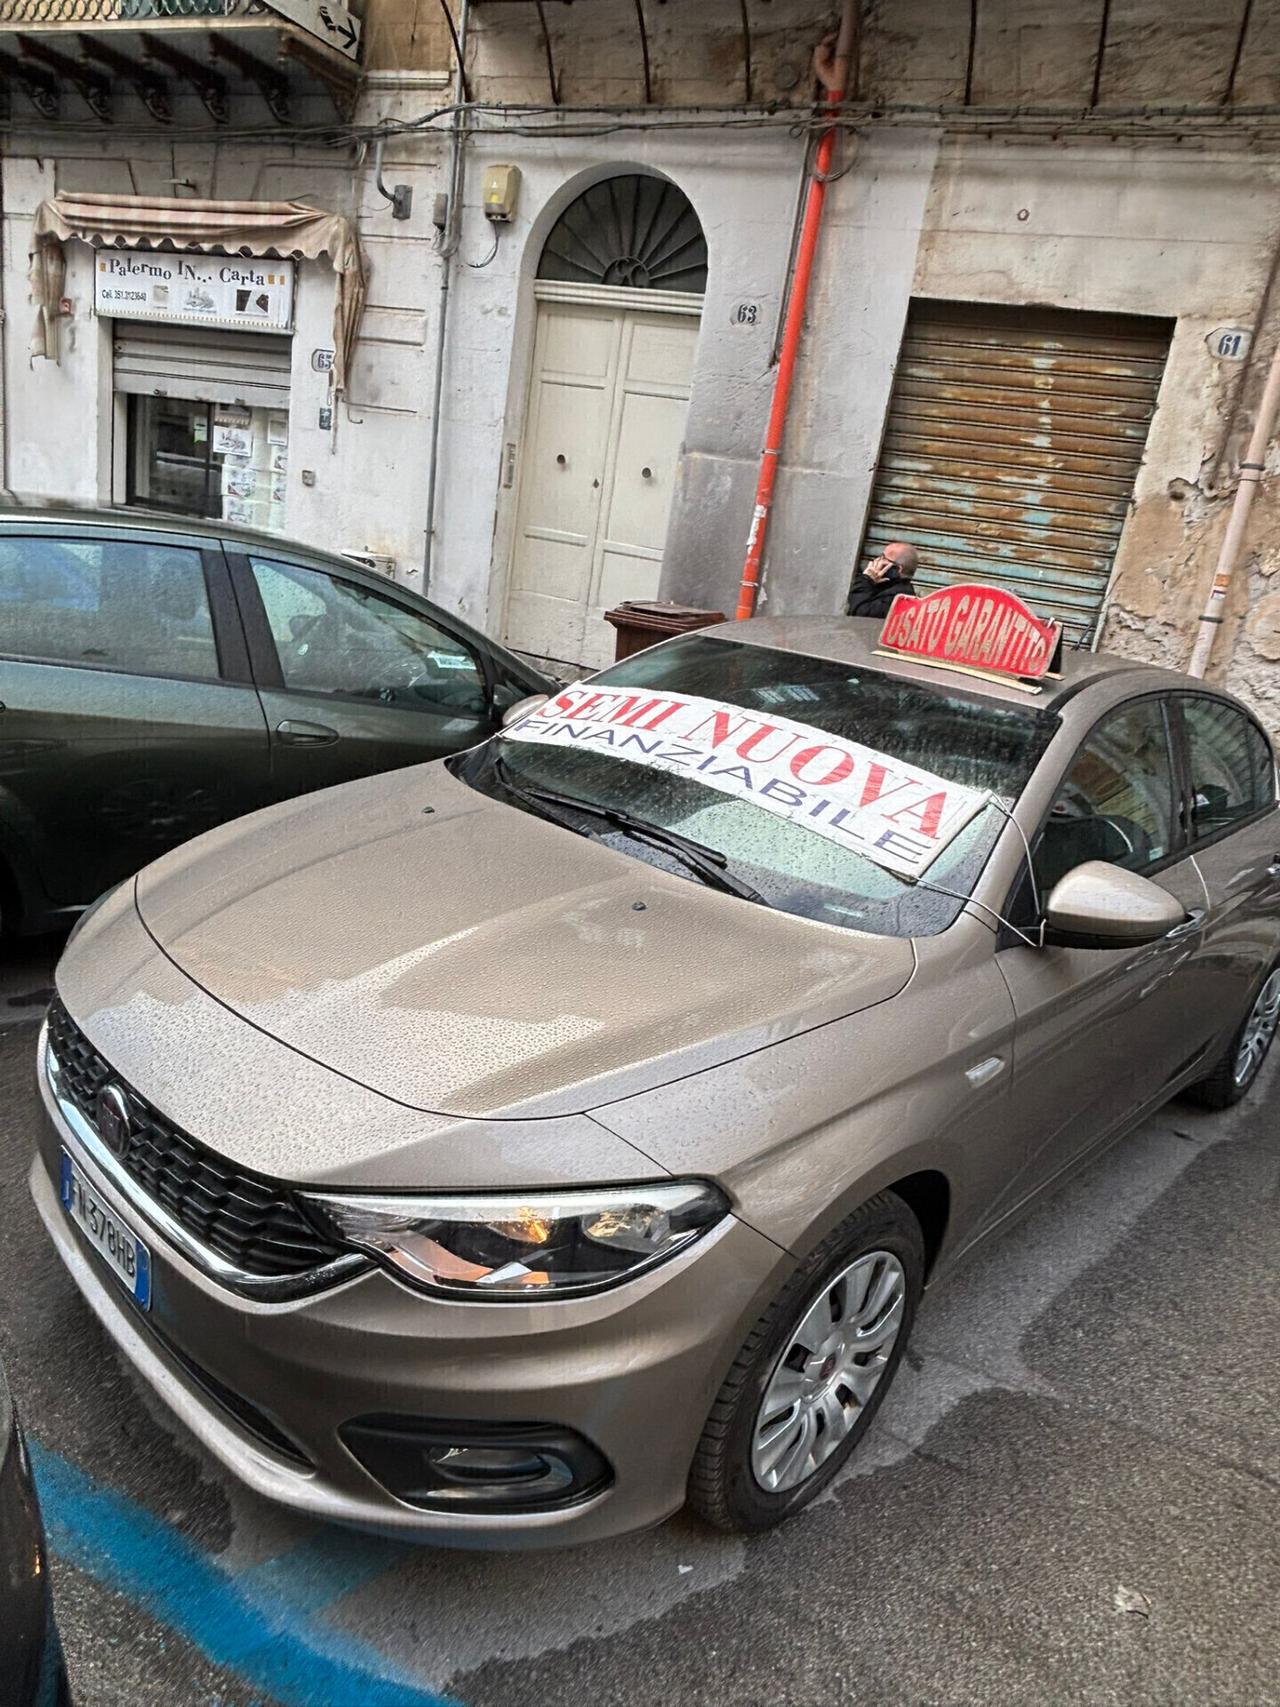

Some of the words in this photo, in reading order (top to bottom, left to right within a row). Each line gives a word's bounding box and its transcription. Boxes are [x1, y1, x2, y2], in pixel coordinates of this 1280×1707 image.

[109, 258, 172, 280] Palermo
[220, 266, 265, 286] Carta
[737, 303, 757, 323] 63
[1217, 334, 1242, 356] 61
[886, 597, 951, 653] USATO
[944, 595, 1047, 673] GARANTITO
[514, 719, 932, 864] FINANZIABILE
[535, 690, 691, 732] SEMI
[677, 709, 948, 840] NUOVA
